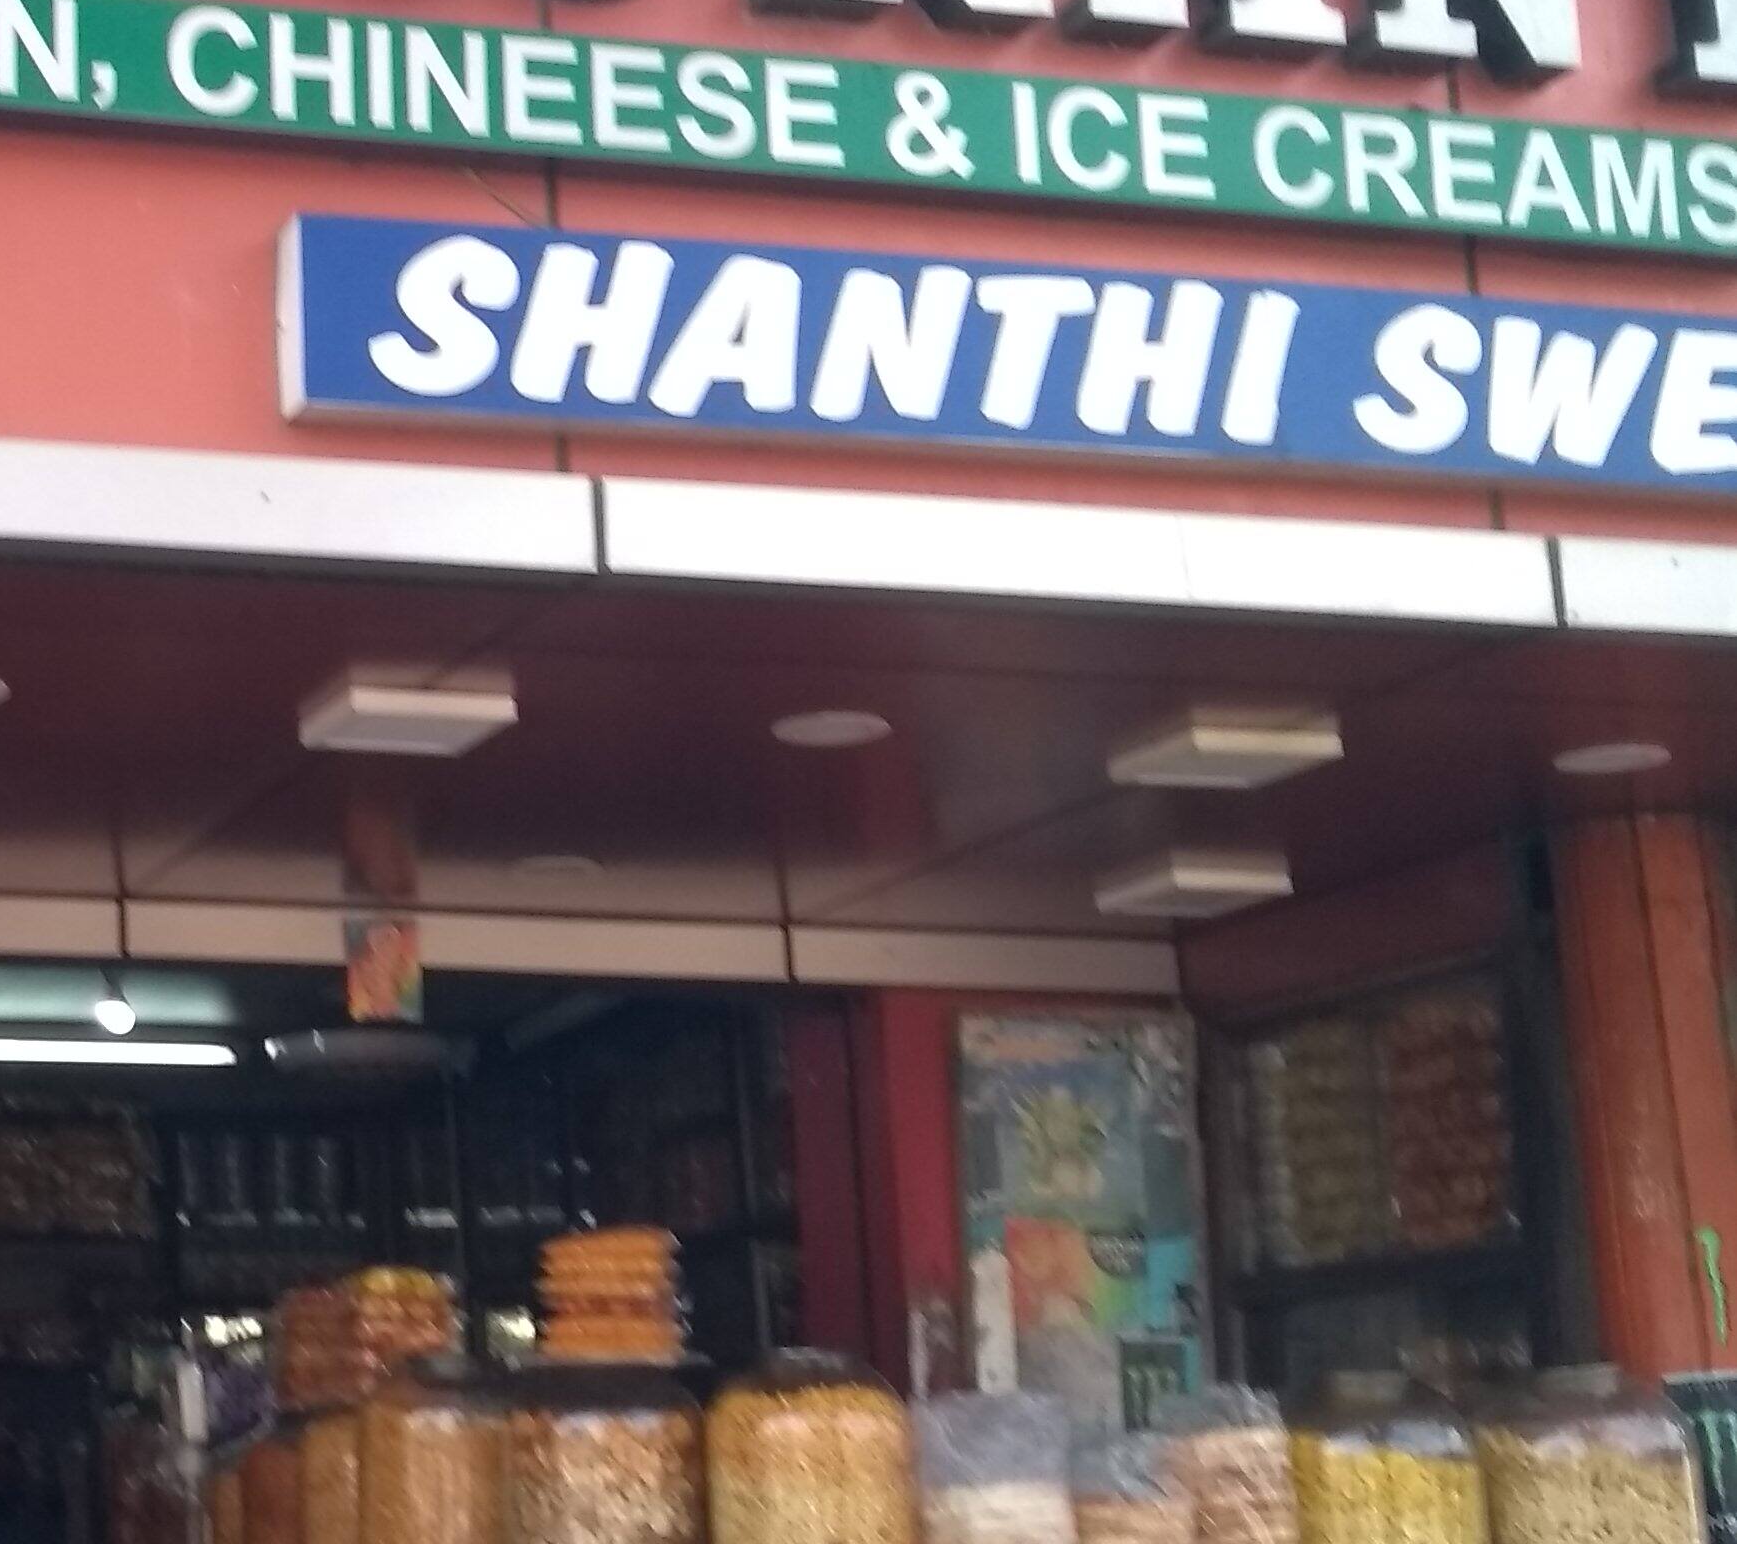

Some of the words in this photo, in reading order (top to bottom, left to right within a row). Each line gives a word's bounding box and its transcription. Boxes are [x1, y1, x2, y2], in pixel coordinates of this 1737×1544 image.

[166, 3, 846, 170] CHINEESE
[885, 69, 976, 183] &
[1011, 80, 1218, 202] ICE
[1252, 101, 1737, 248] CREAMS
[366, 231, 1301, 448] SHANTHI
[1353, 302, 1737, 475] SWE
